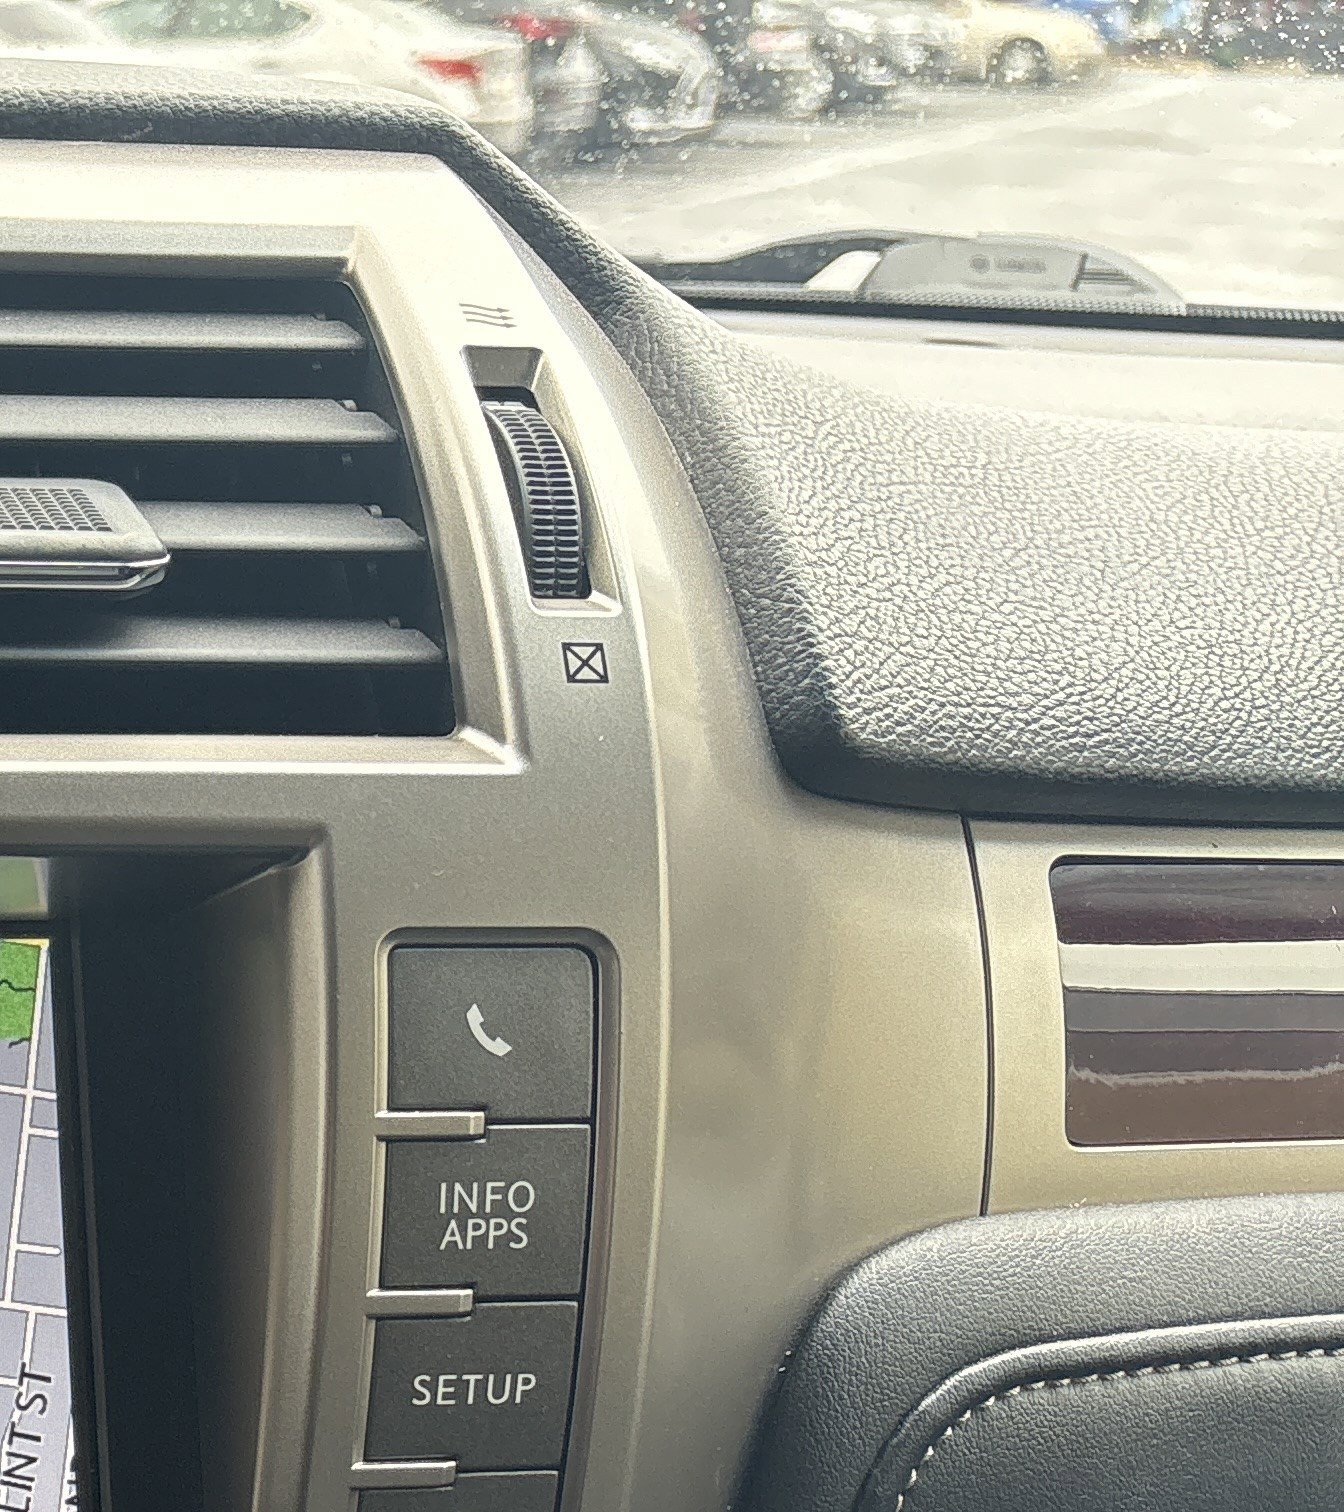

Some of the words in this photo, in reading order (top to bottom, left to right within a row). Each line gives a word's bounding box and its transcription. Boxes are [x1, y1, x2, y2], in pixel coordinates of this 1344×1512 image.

[438, 1181, 537, 1215] INFO
[438, 1219, 530, 1251] APPS
[15, 1361, 52, 1416] ST
[411, 1373, 538, 1407] SETUP
